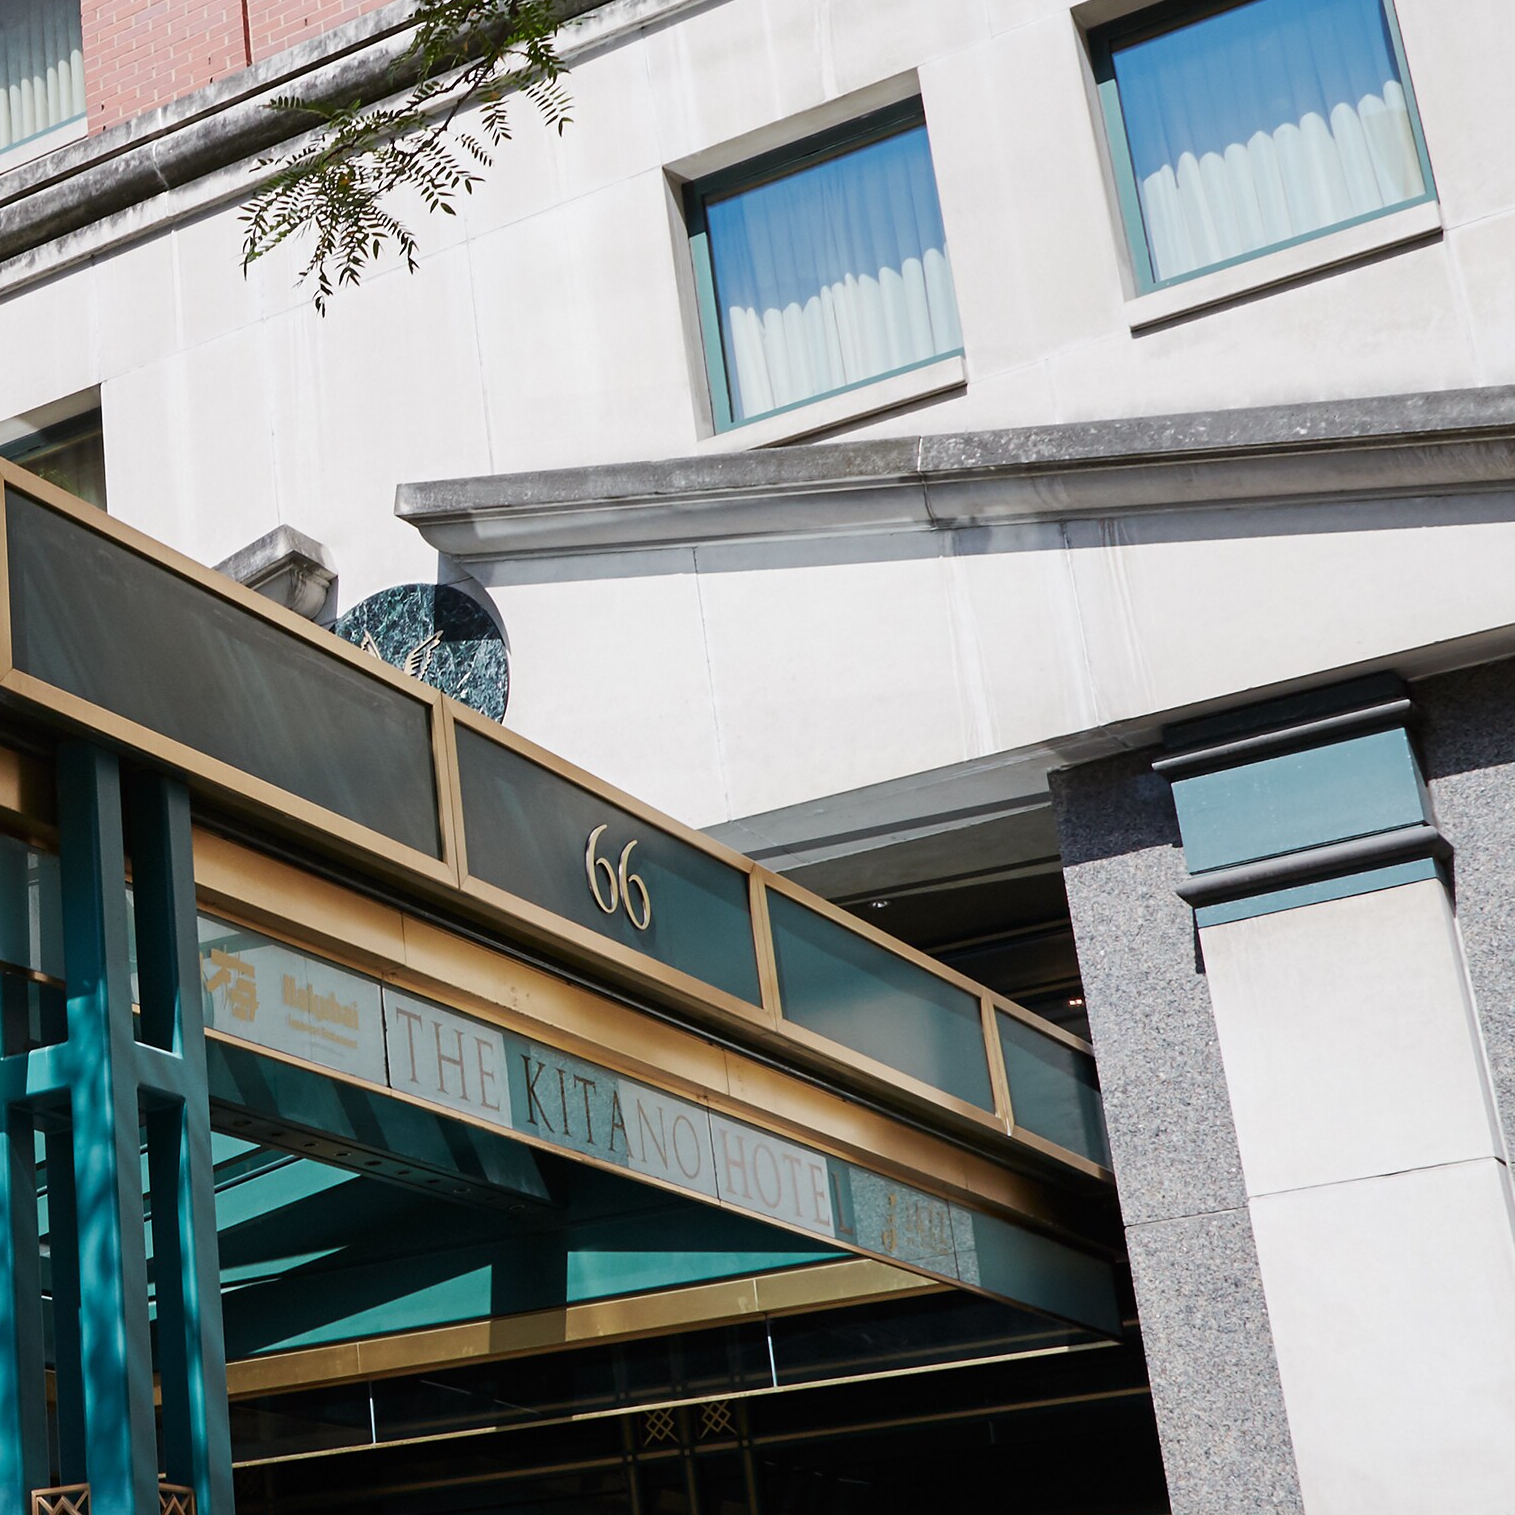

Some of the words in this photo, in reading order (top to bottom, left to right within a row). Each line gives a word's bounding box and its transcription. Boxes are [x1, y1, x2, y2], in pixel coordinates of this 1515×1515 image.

[584, 822, 652, 932] 66
[395, 1006, 501, 1113] THE
[519, 1053, 702, 1181] KITANO
[718, 1128, 855, 1236] HOTEL
